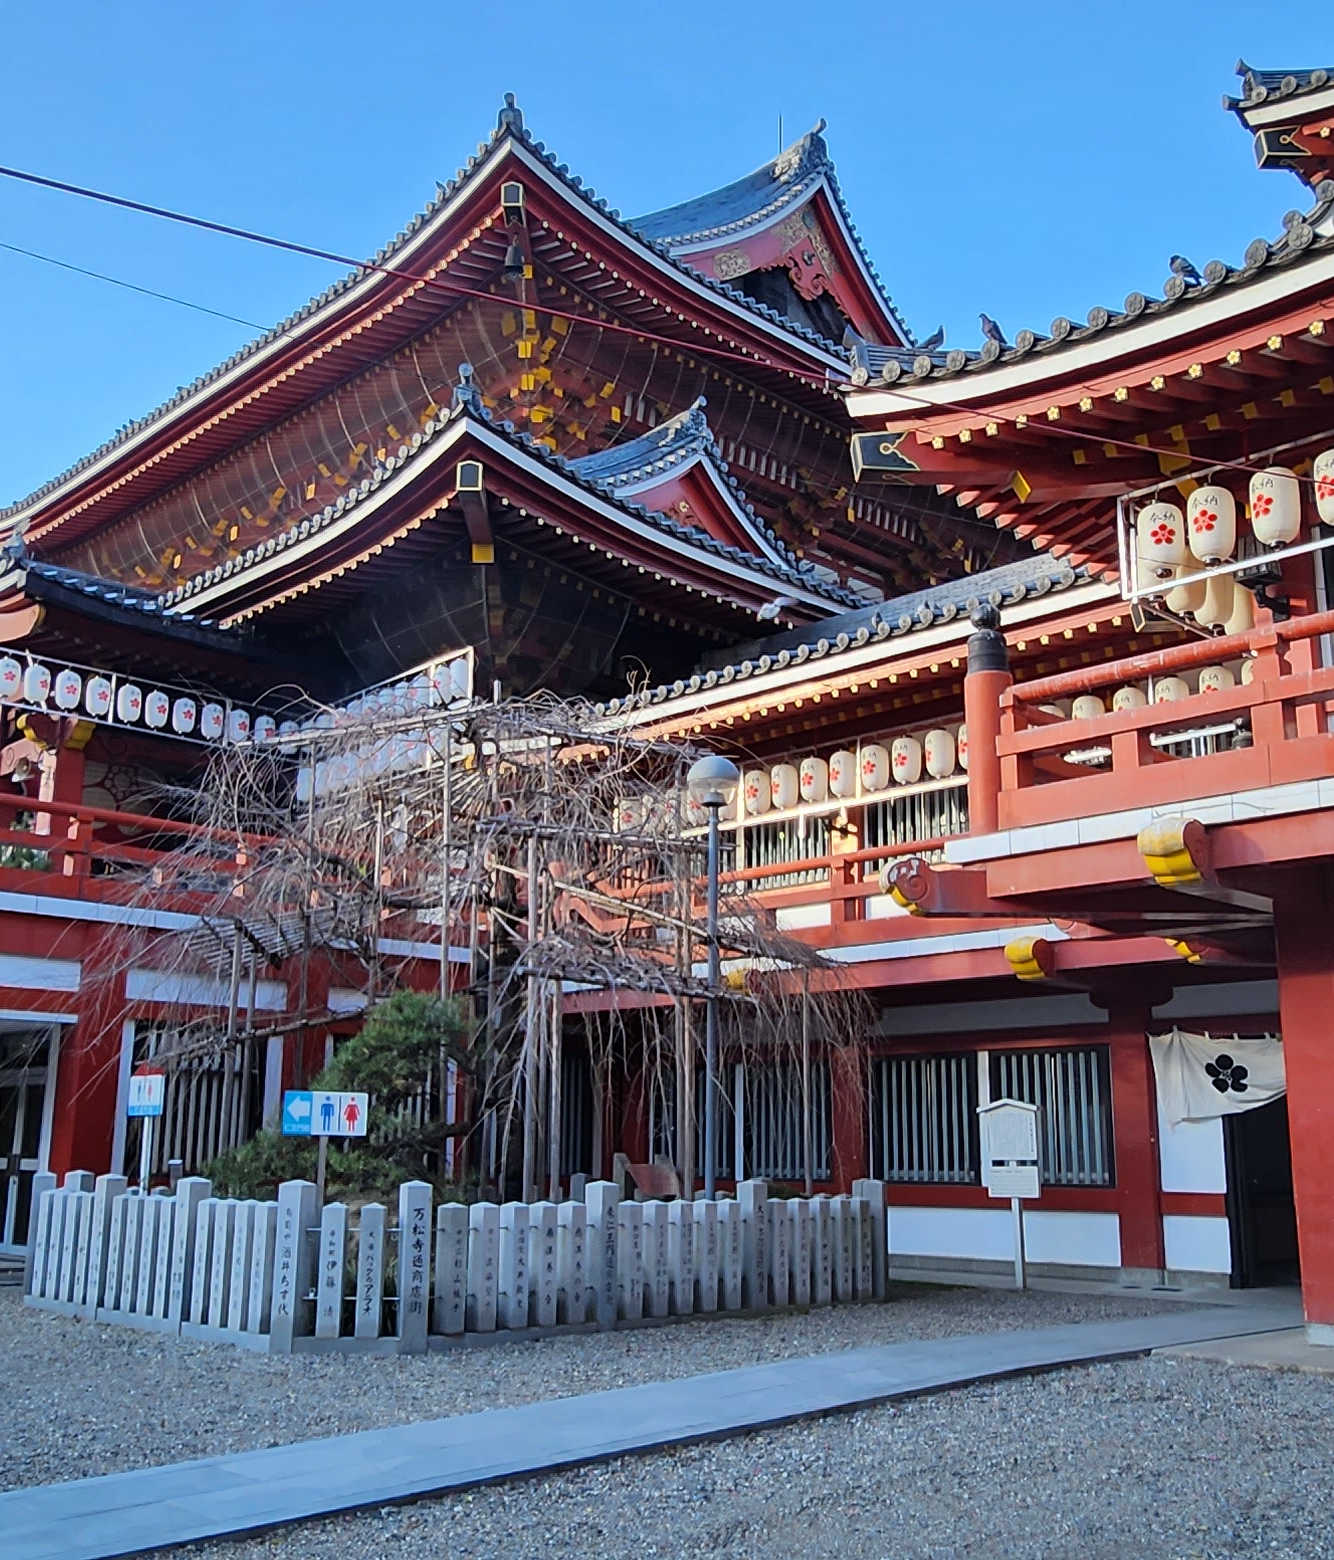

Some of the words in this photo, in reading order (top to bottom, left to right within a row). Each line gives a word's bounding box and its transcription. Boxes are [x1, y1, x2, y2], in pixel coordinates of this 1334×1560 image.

[409, 1207, 426, 1315] 万松寺通商店街
